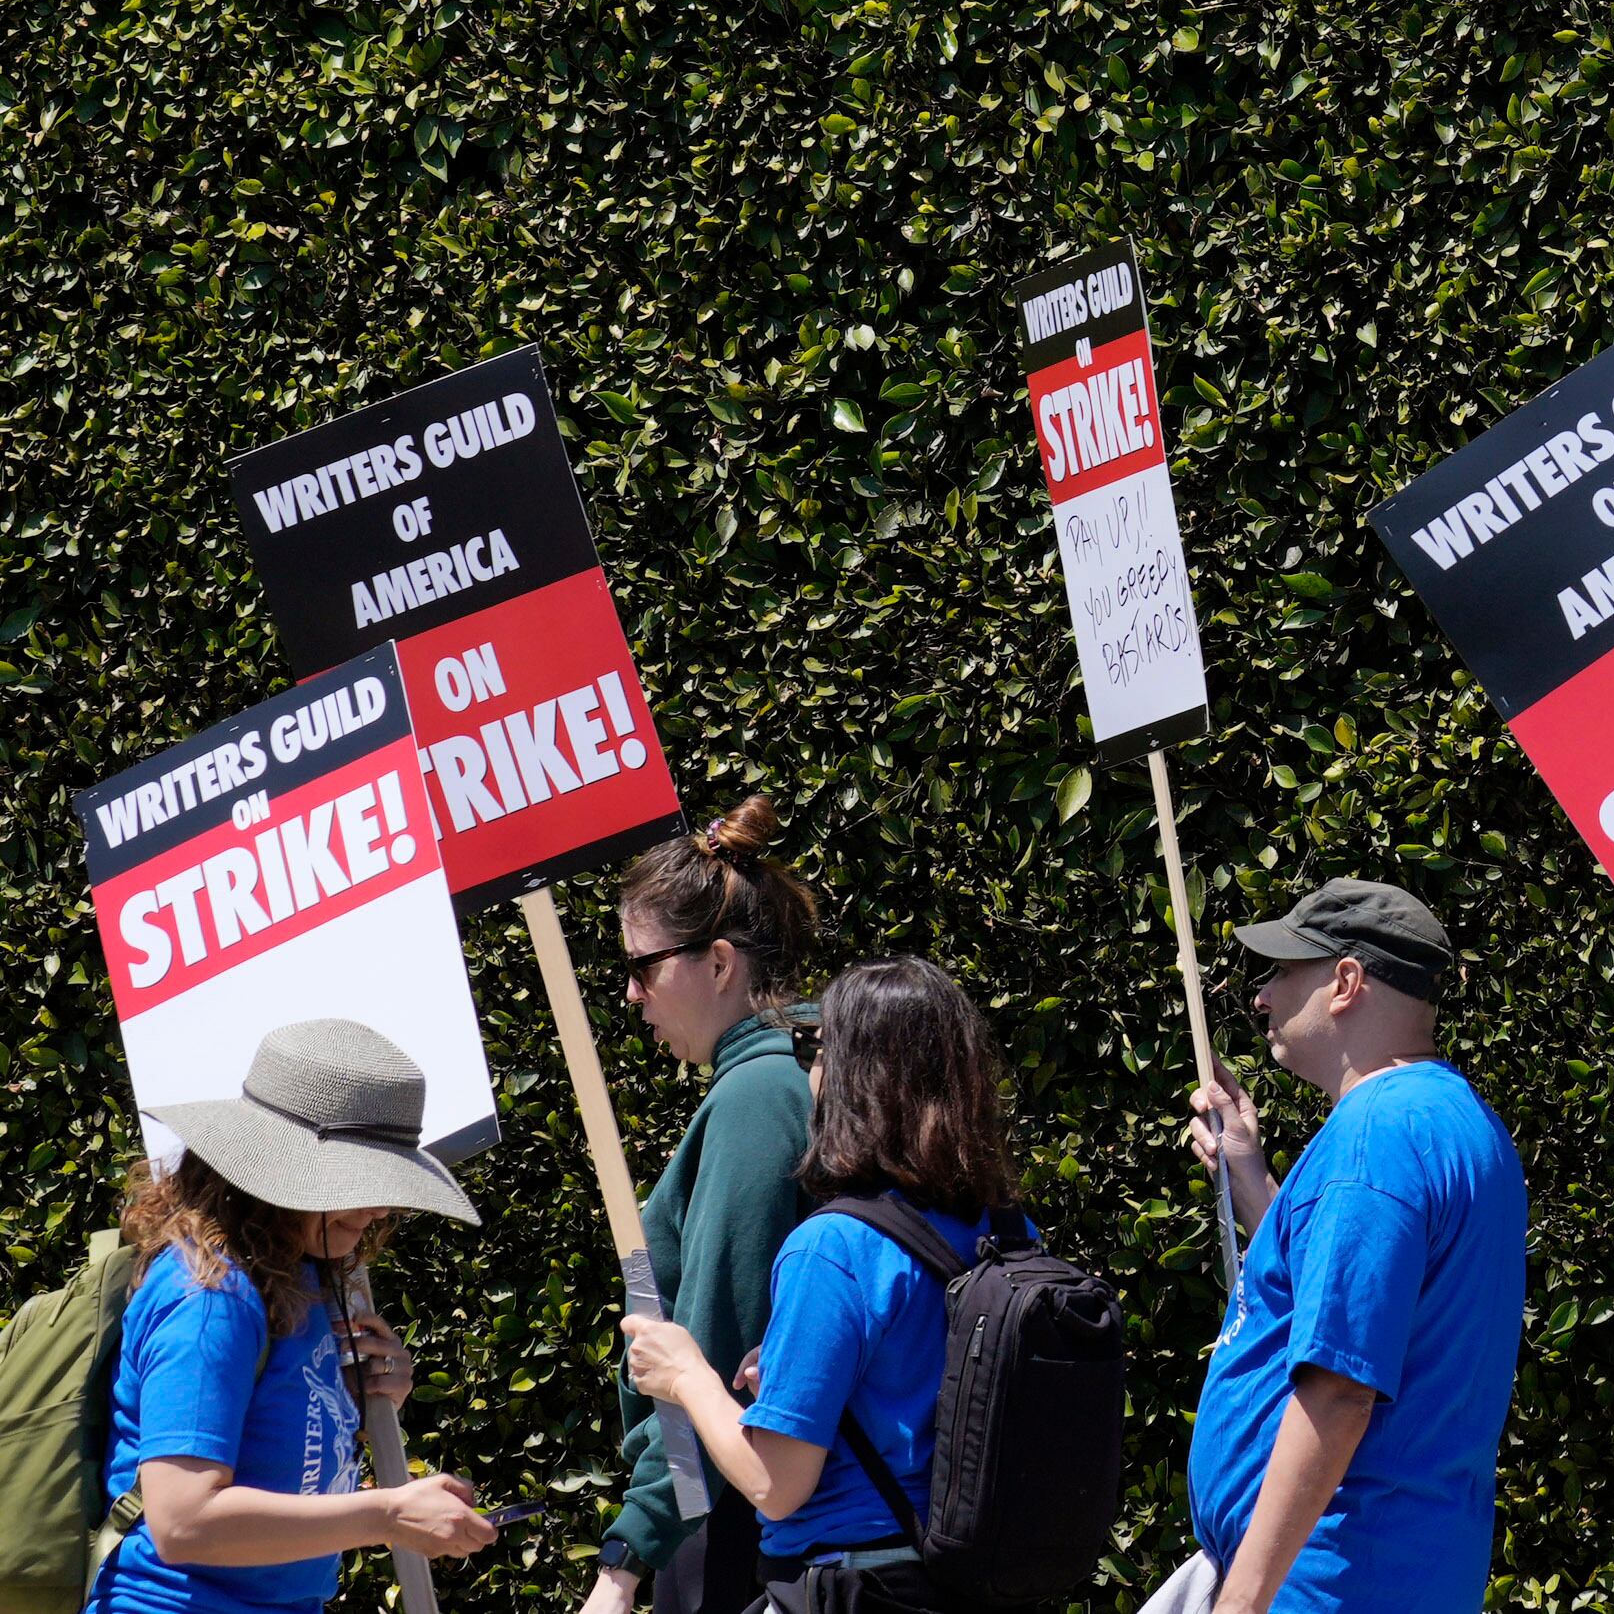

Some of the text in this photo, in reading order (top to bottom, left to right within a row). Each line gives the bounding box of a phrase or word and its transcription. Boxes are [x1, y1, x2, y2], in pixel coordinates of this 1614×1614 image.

[1023, 263, 1132, 344] WRITERS GUILD
[1076, 337, 1092, 368] ON
[253, 393, 535, 533] WRITERS GUILD
[1040, 358, 1153, 481] STRIKE!
[393, 497, 432, 542] OF
[1066, 515, 1103, 566] PAY
[352, 529, 519, 628] AMERICA
[1084, 546, 1179, 640] YOU GREEDY
[435, 642, 506, 712] ON
[96, 677, 386, 848] WRITERS GUILD
[418, 671, 647, 841] RIKE!
[232, 790, 270, 831] ON
[120, 770, 416, 988] STRIKE!
